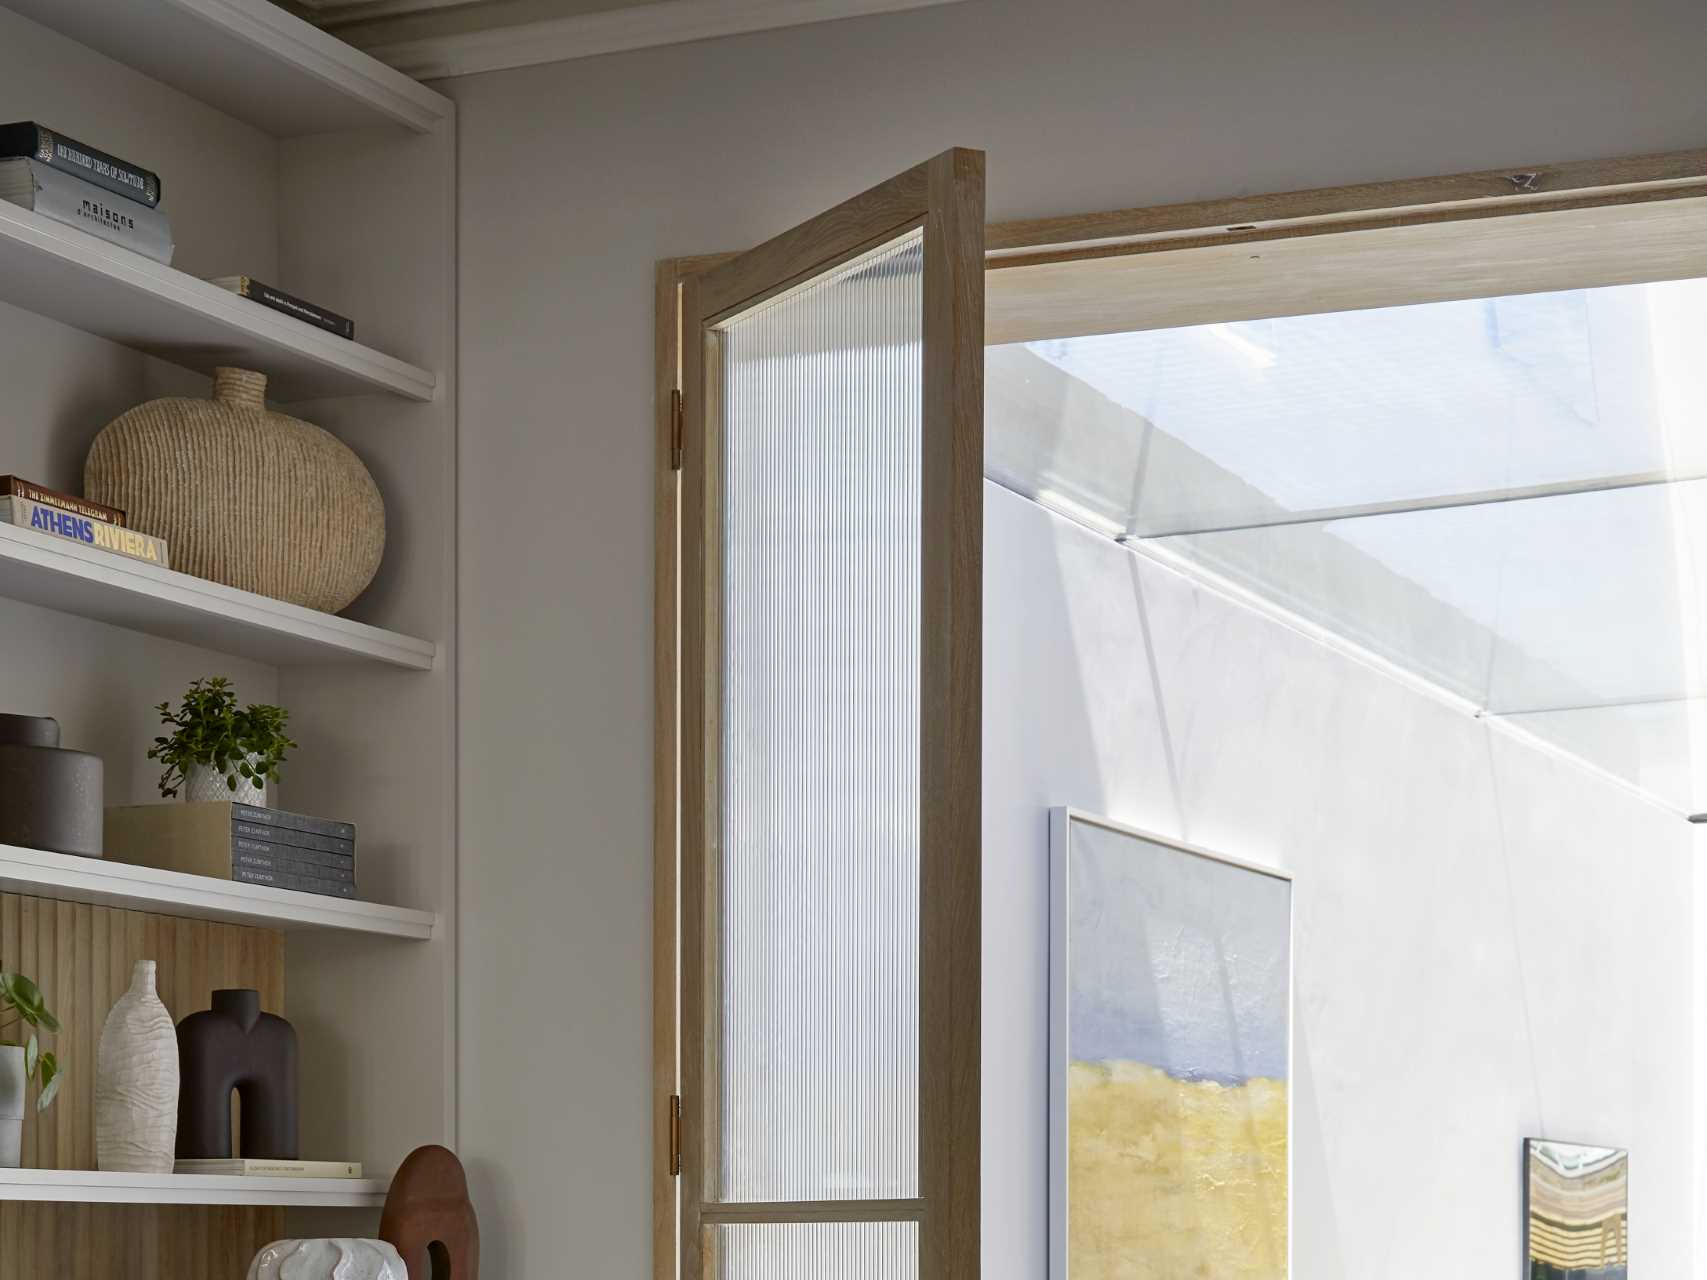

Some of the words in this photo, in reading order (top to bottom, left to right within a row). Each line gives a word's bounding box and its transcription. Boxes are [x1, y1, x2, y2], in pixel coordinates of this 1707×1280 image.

[93, 159, 110, 177] YEARS
[82, 200, 134, 229] maisons
[29, 489, 39, 501] THE
[40, 493, 77, 512] ZIMMERMANN
[78, 504, 108, 521] TELEGRAM
[31, 505, 94, 544] ATHENS
[93, 522, 157, 560] RIVIERA
